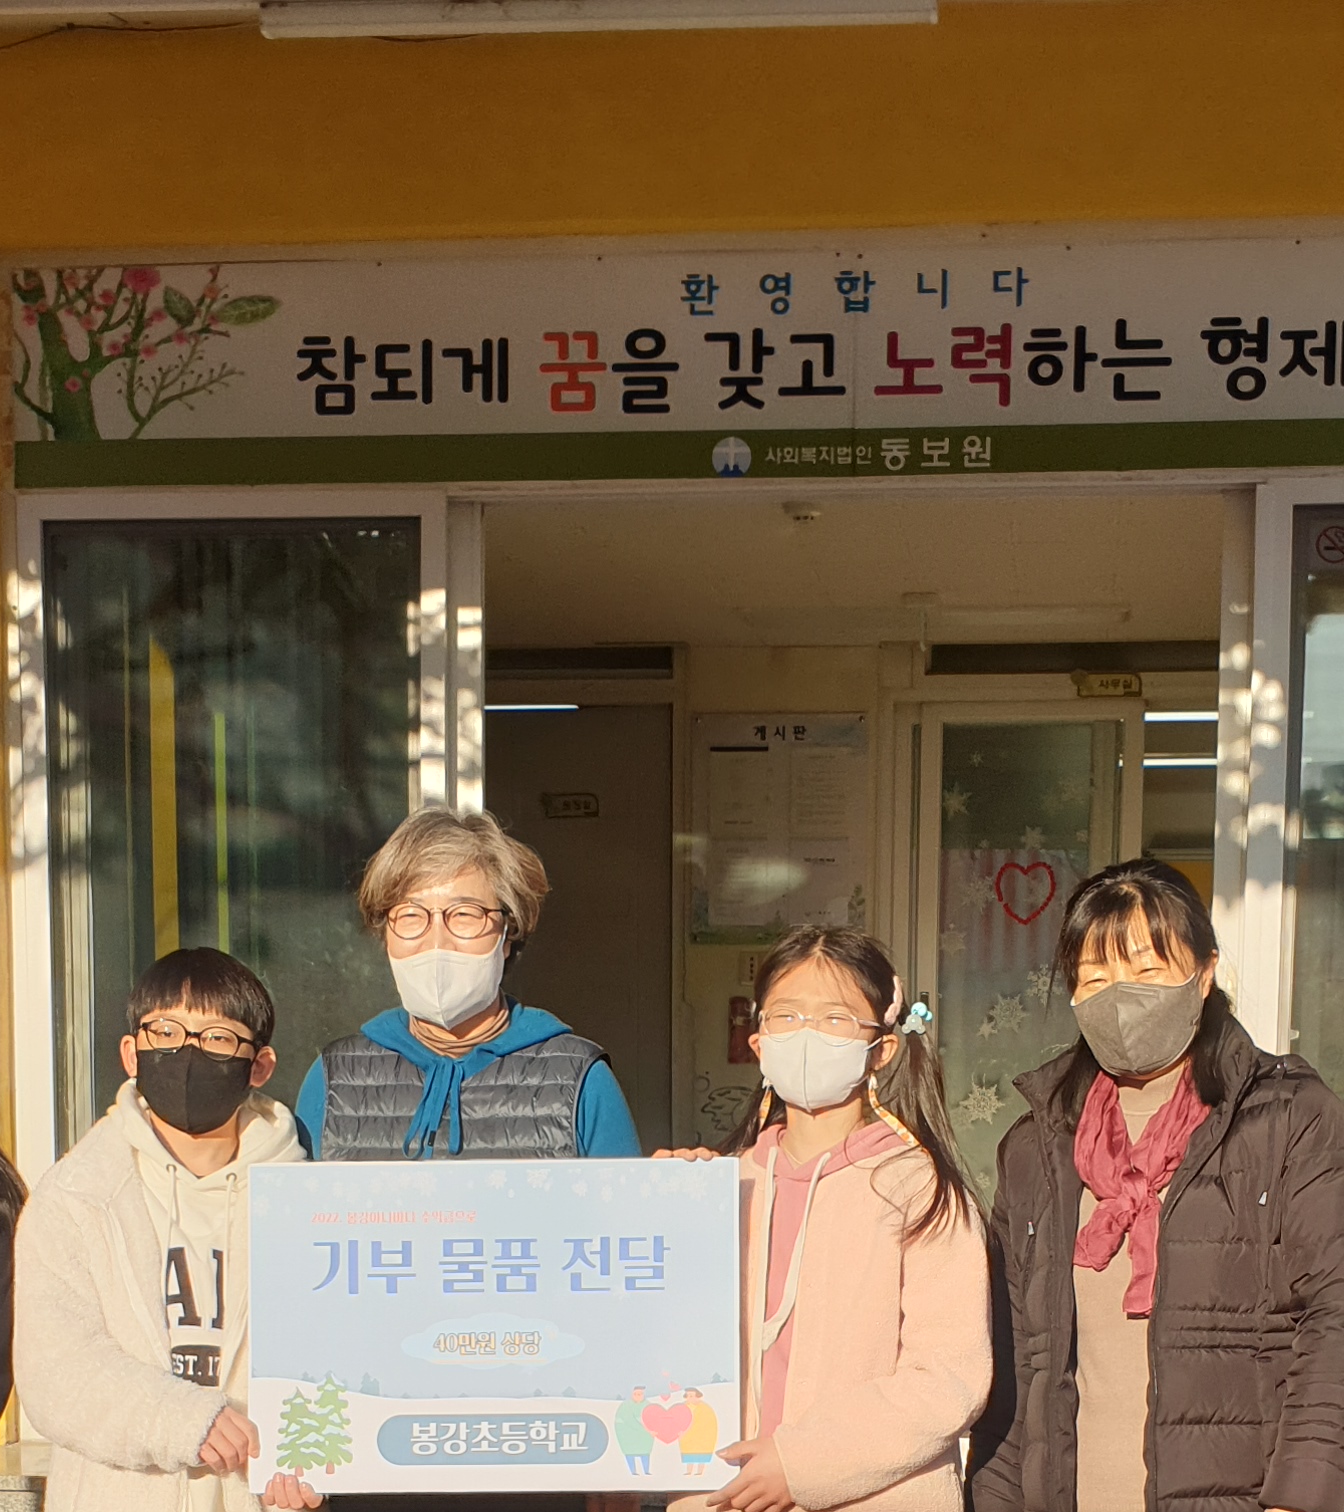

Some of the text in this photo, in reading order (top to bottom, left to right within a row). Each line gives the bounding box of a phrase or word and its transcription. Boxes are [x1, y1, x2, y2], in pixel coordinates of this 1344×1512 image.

[296, 334, 510, 416] 참되게
[538, 328, 680, 413] 꿈을
[703, 327, 847, 410] 갖고
[873, 317, 1173, 407] 노력하는
[765, 436, 993, 471] 사회복지법인 동보원
[754, 725, 807, 741] 게시판
[311, 1234, 671, 1294] 기부 물품 전달
[433, 1331, 542, 1356] 40만원 상당
[410, 1421, 589, 1456] 봉강초등학교
